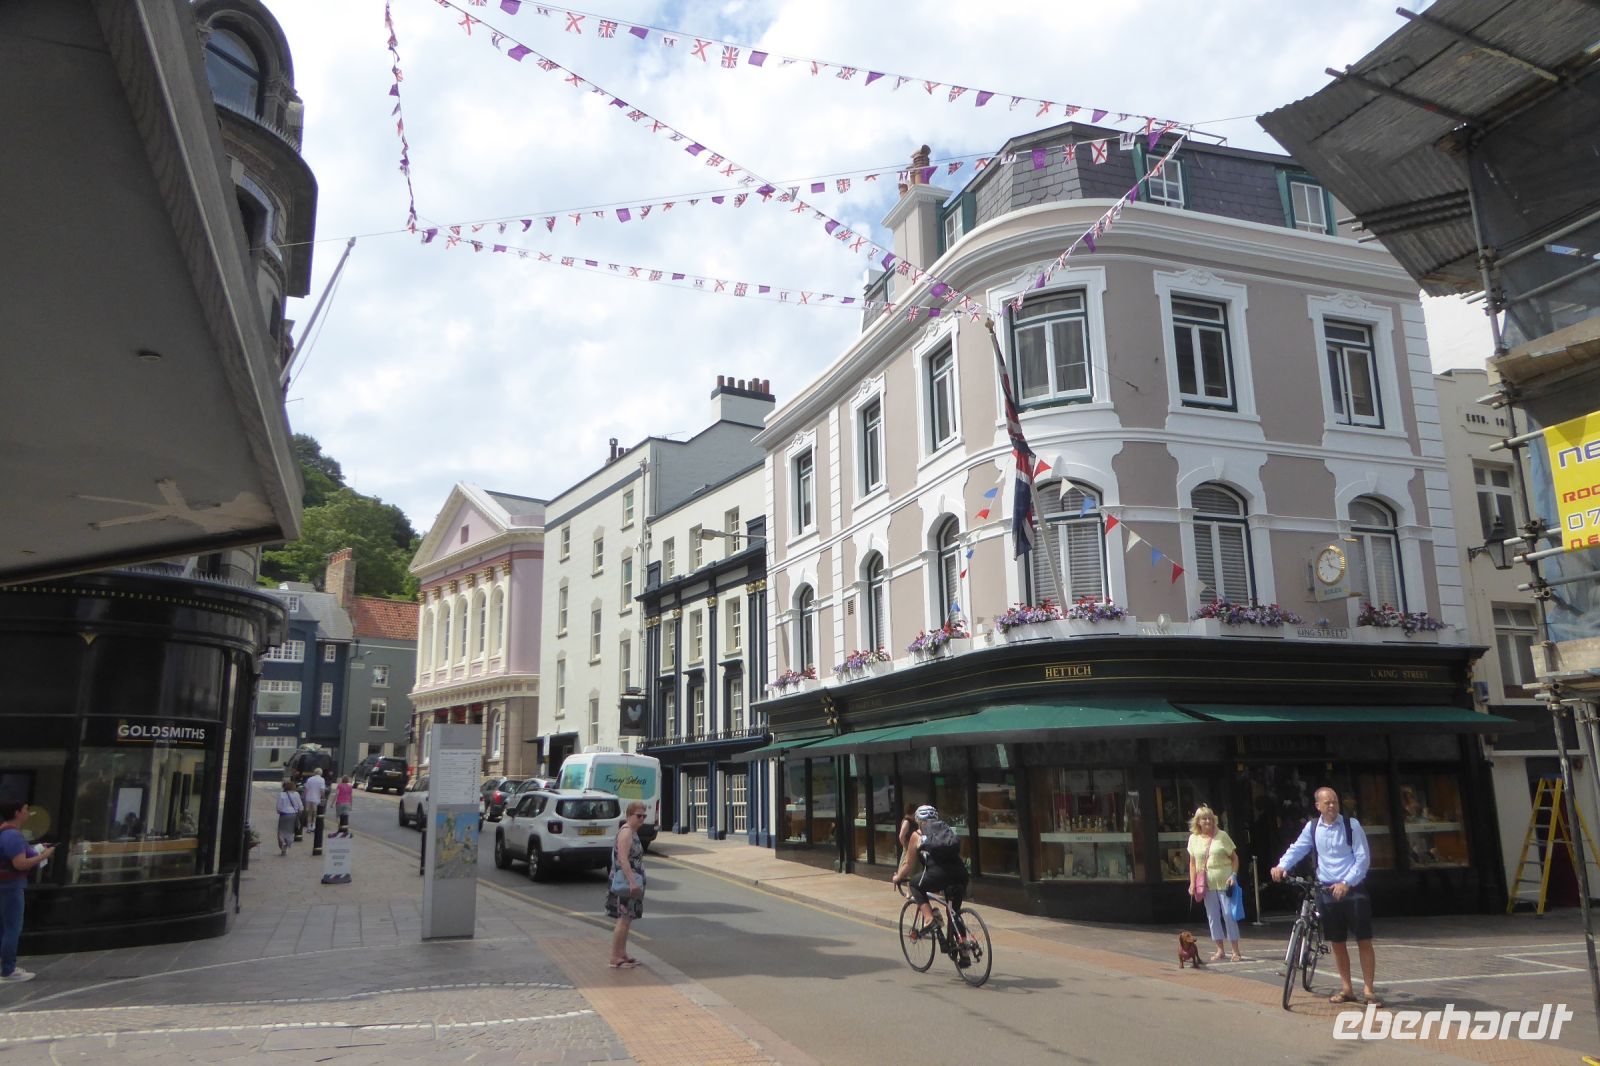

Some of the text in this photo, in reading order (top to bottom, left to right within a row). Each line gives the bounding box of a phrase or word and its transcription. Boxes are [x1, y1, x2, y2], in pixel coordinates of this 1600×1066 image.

[1568, 508, 1600, 530] 07
[1317, 629, 1345, 638] STREET
[1044, 665, 1092, 678] HETTICH
[118, 724, 205, 740] GOLDSMITHS
